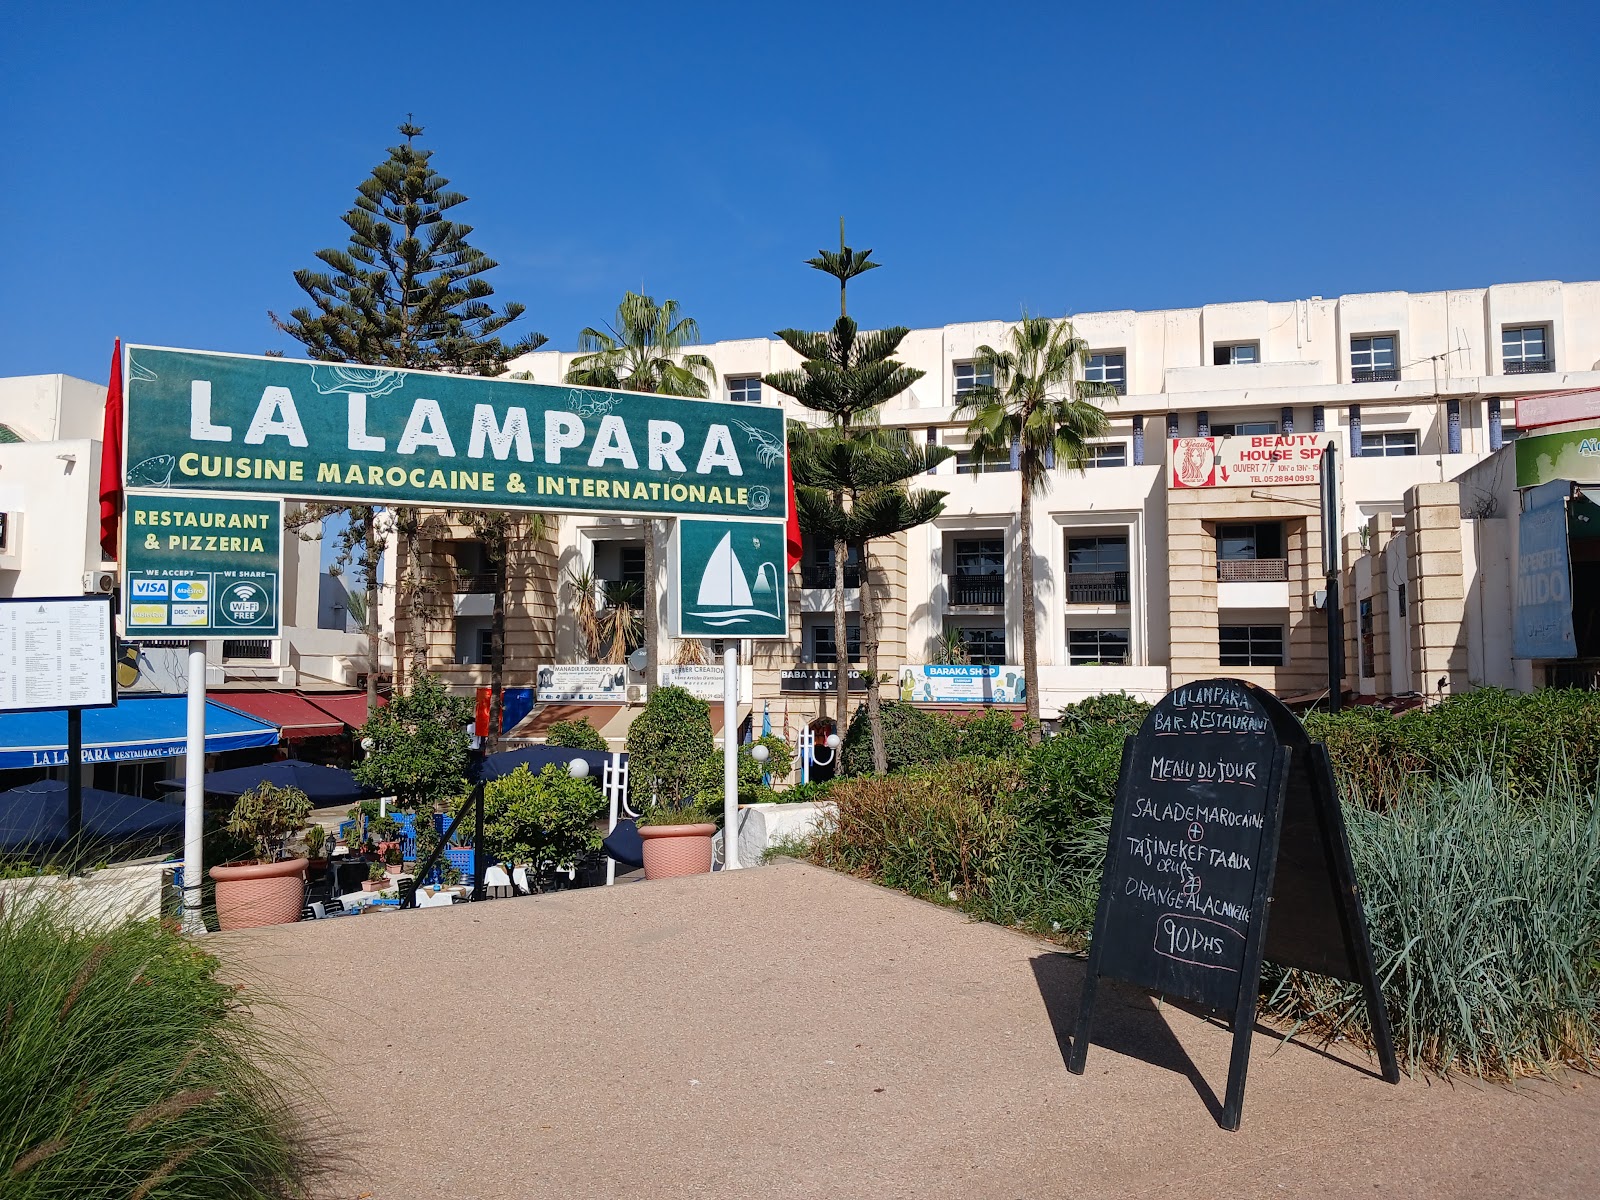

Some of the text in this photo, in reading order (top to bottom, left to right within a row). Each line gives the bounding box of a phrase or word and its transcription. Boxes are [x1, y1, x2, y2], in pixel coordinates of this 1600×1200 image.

[190, 380, 743, 476] LA LAMPARA
[1251, 435, 1318, 447] BEAUTY
[1579, 438, 1600, 453] Aï
[1240, 448, 1325, 461] HOUSE SP
[1233, 463, 1260, 472] OUVERT
[1262, 463, 1275, 473] 7/7
[179, 453, 748, 505] CUISINE MAROCAINE & INTERNATIONALE
[134, 510, 270, 529] RESTAURANT
[144, 533, 265, 552] & PIZZERIA
[136, 582, 166, 592] VISA
[1518, 570, 1565, 606] MIDO
[231, 602, 258, 611] Wi-Fi
[930, 667, 996, 675] BARAKA SHOP
[32, 752, 51, 766] LA
[53, 748, 111, 764] LAPARA
[1151, 756, 1195, 779] MENU
